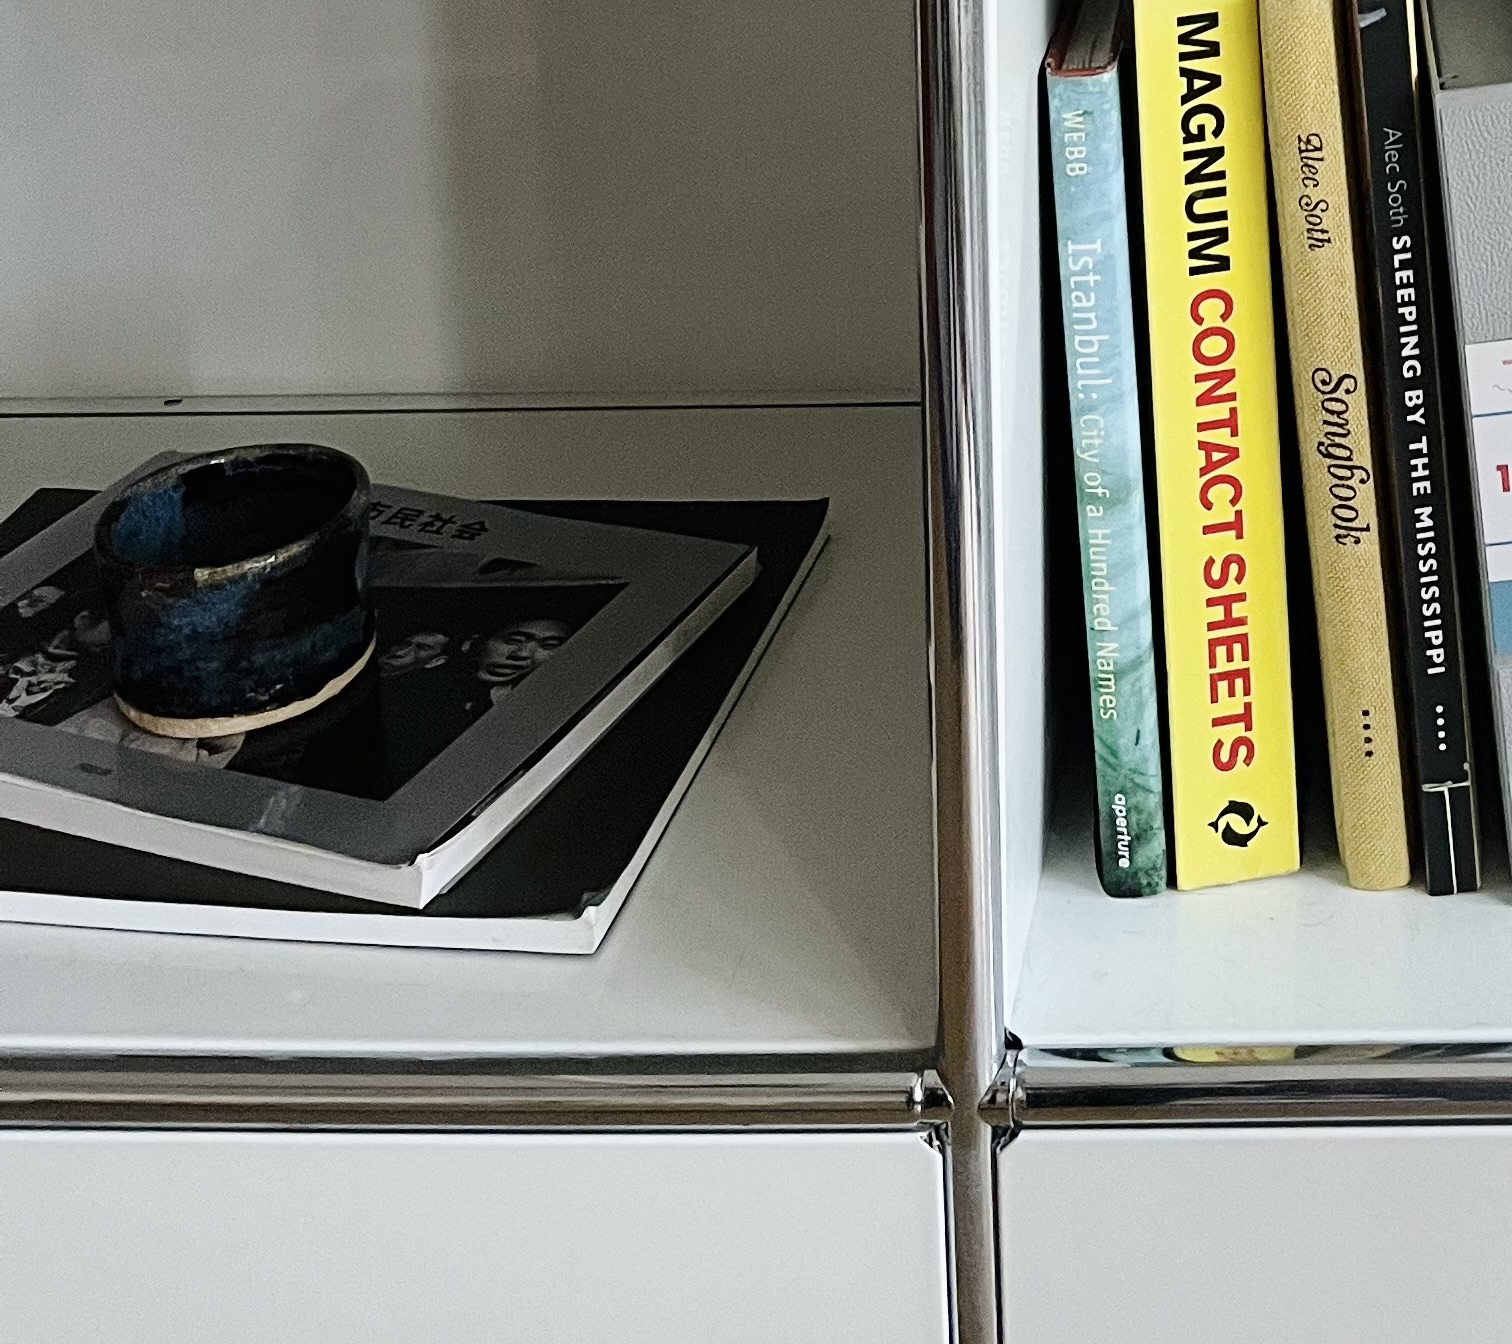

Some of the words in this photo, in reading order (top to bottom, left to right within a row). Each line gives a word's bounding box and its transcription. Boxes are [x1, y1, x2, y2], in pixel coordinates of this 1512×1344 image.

[1062, 109, 1088, 177] WEBB
[1176, 11, 1231, 277] MAGNUM
[1297, 133, 1325, 189] Alec
[1383, 127, 1403, 174] Alec
[1299, 194, 1332, 251] Soth
[1387, 179, 1409, 228] Soth
[1067, 239, 1113, 399] Istanbul:
[1392, 234, 1422, 379] SLEEPING
[1076, 414, 1105, 462] City
[1190, 288, 1244, 541] CONTACT
[1404, 389, 1426, 425] BY
[1083, 471, 1110, 499] of
[1311, 367, 1371, 546] Songbook
[1408, 436, 1432, 496] THE
[1086, 505, 1104, 517] a
[1088, 528, 1119, 632] Hundred
[1414, 506, 1446, 675] MISSISSIPPI
[1096, 641, 1118, 721] Names
[1203, 553, 1255, 773] SHEETS
[1111, 793, 1132, 868] aperture
